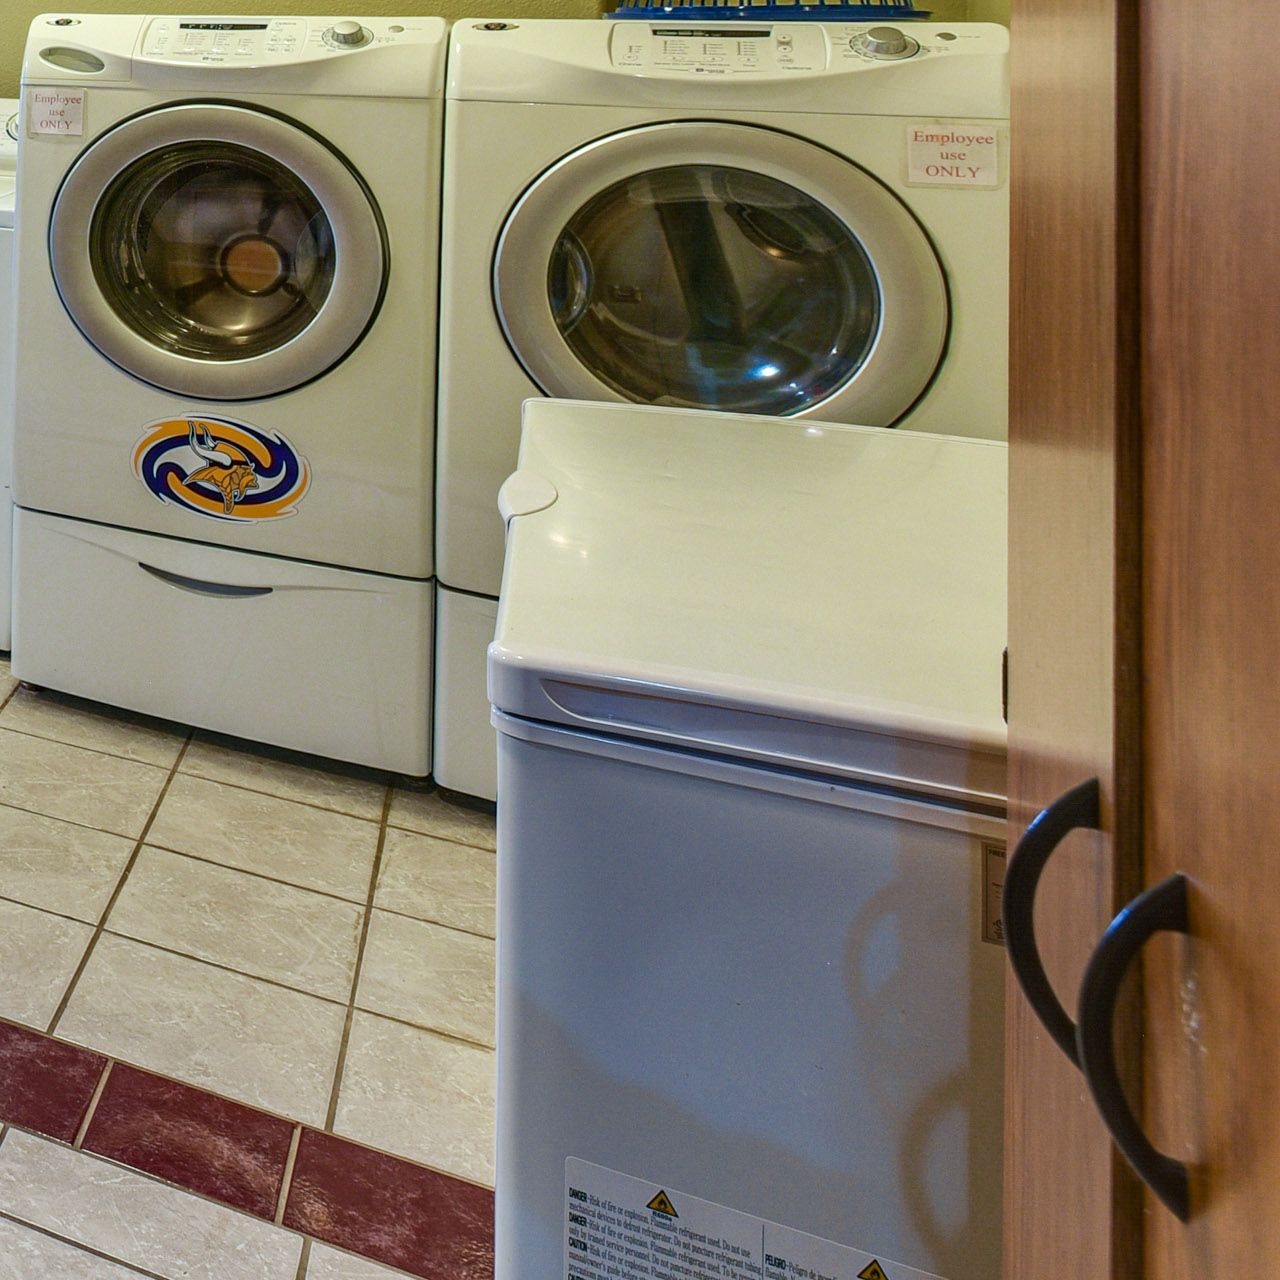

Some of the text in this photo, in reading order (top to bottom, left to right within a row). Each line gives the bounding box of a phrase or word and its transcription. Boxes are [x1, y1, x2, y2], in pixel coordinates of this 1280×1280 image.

[35, 94, 82, 106] Employee
[40, 120, 72, 130] ONLY
[913, 130, 994, 146] Employee
[940, 151, 966, 160] use
[925, 165, 980, 178] ONLY
